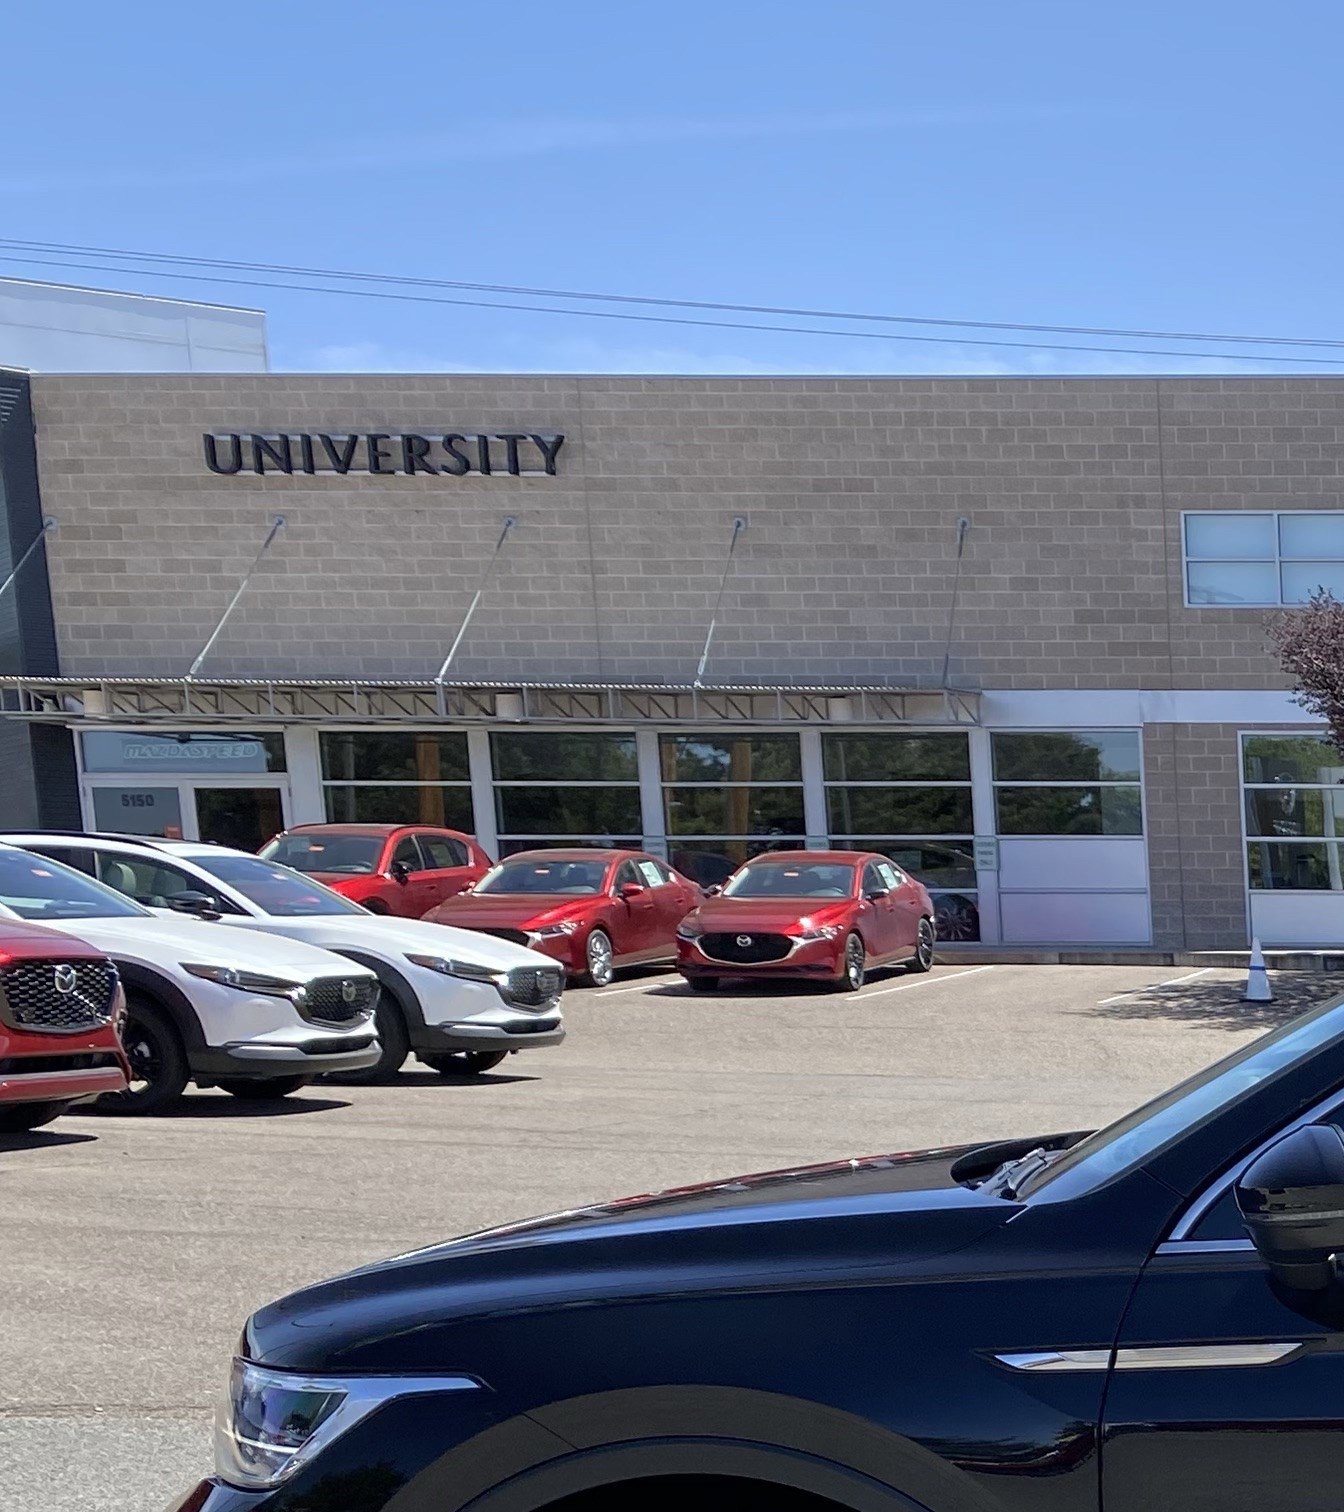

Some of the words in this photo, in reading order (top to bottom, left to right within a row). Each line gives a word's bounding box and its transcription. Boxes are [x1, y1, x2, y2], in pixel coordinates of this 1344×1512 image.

[202, 432, 566, 477] UNIVERSITY
[123, 742, 259, 760] MAZDASPEED
[121, 793, 155, 808] 5150
